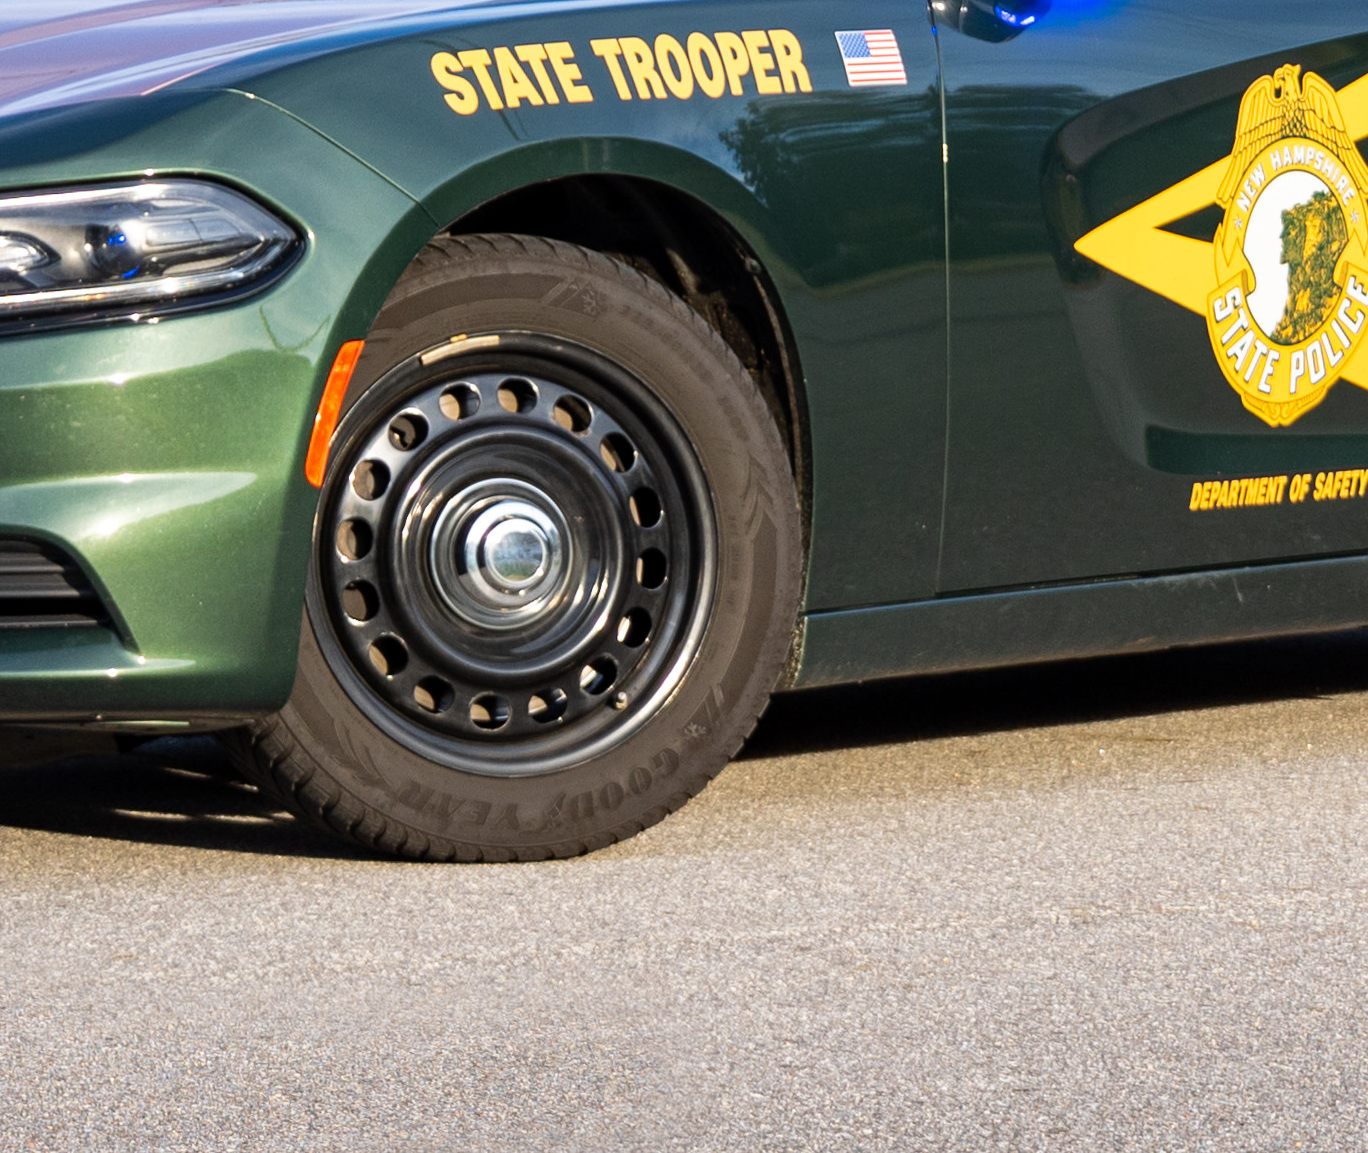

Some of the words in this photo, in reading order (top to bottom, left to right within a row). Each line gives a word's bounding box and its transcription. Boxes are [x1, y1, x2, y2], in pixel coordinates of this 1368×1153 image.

[430, 41, 594, 115] STATE
[590, 29, 813, 100] TROOPER
[1237, 163, 1265, 212] NEW
[1270, 144, 1355, 206] HAMPSHIRE
[1214, 287, 1280, 394] STATE
[1189, 475, 1287, 511] DEPARTMENT
[1289, 473, 1312, 503] OF
